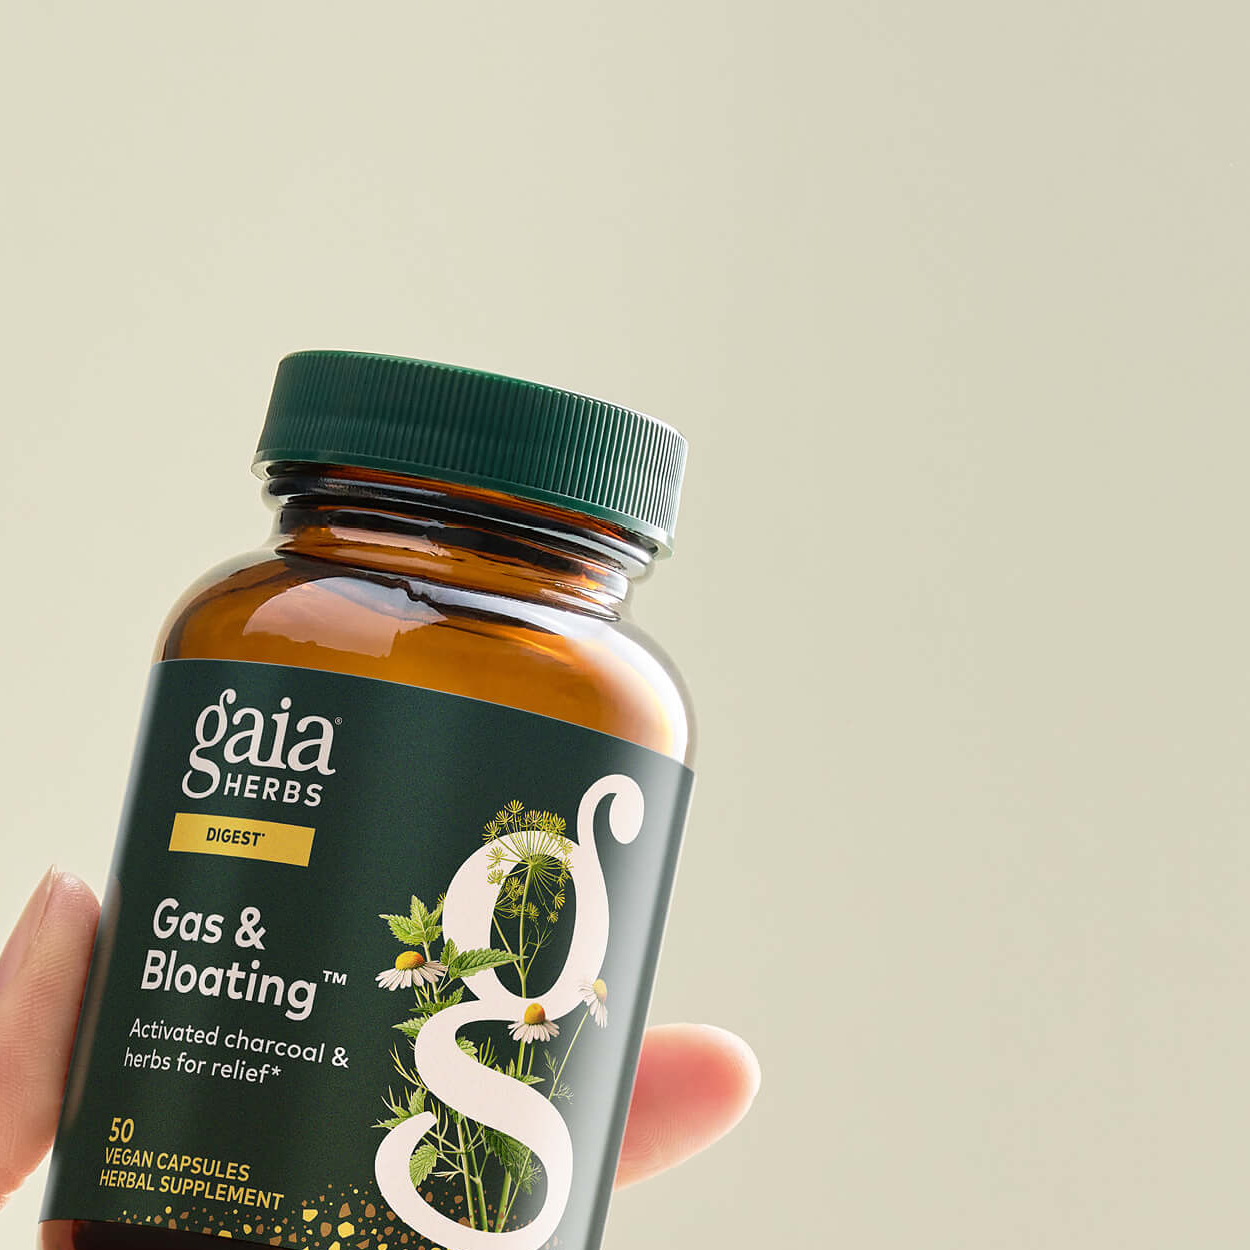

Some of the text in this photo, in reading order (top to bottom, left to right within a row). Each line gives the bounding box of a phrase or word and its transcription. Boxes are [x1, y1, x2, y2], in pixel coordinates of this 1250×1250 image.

[223, 772, 324, 807] HERBS
[153, 898, 267, 950] Gas &
[124, 1047, 171, 1071] herbs
[176, 1052, 206, 1075] for
[129, 1018, 350, 1069] Activated charcoal &
[108, 1117, 135, 1143] 50
[104, 1147, 251, 1182] VEGAN CAPSULES
[99, 1169, 285, 1211] HERBAL SUPPLEMENT
